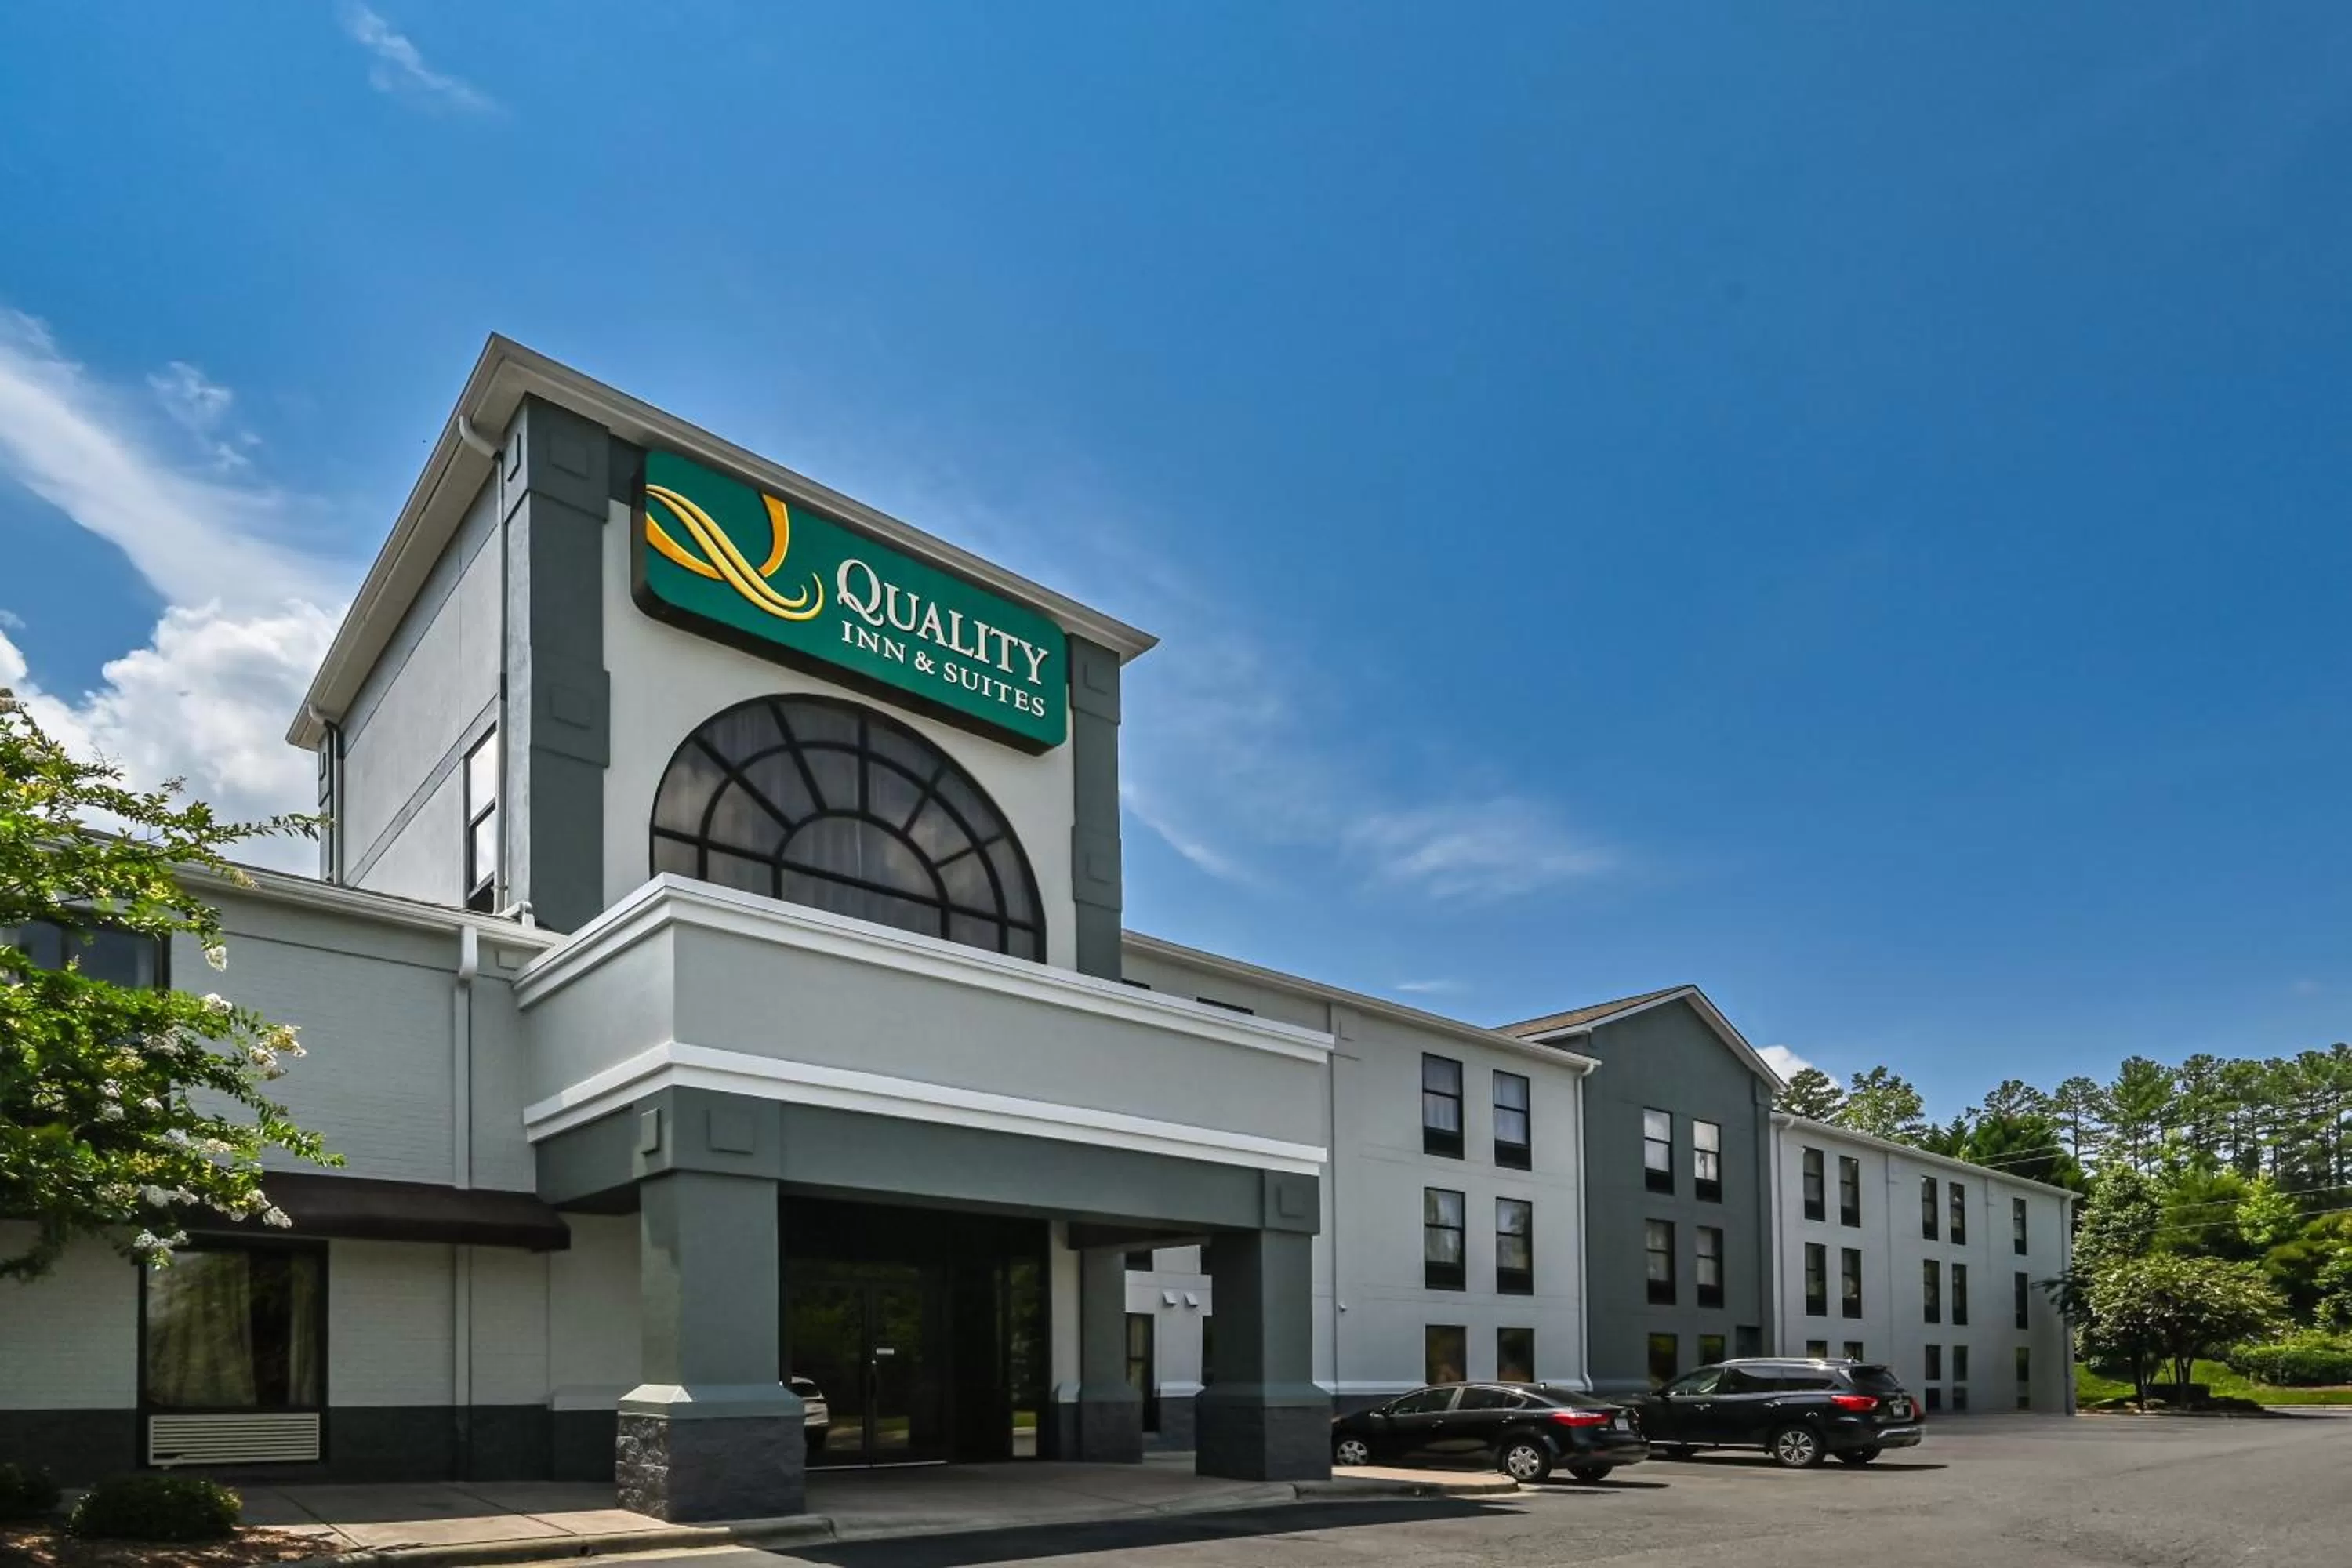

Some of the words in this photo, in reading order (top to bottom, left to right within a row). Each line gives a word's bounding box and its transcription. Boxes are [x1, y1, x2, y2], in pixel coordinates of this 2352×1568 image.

[837, 559, 1048, 684] QUALITY
[842, 620, 906, 663] INN
[914, 650, 935, 675] &
[943, 662, 1045, 717] SUITES
